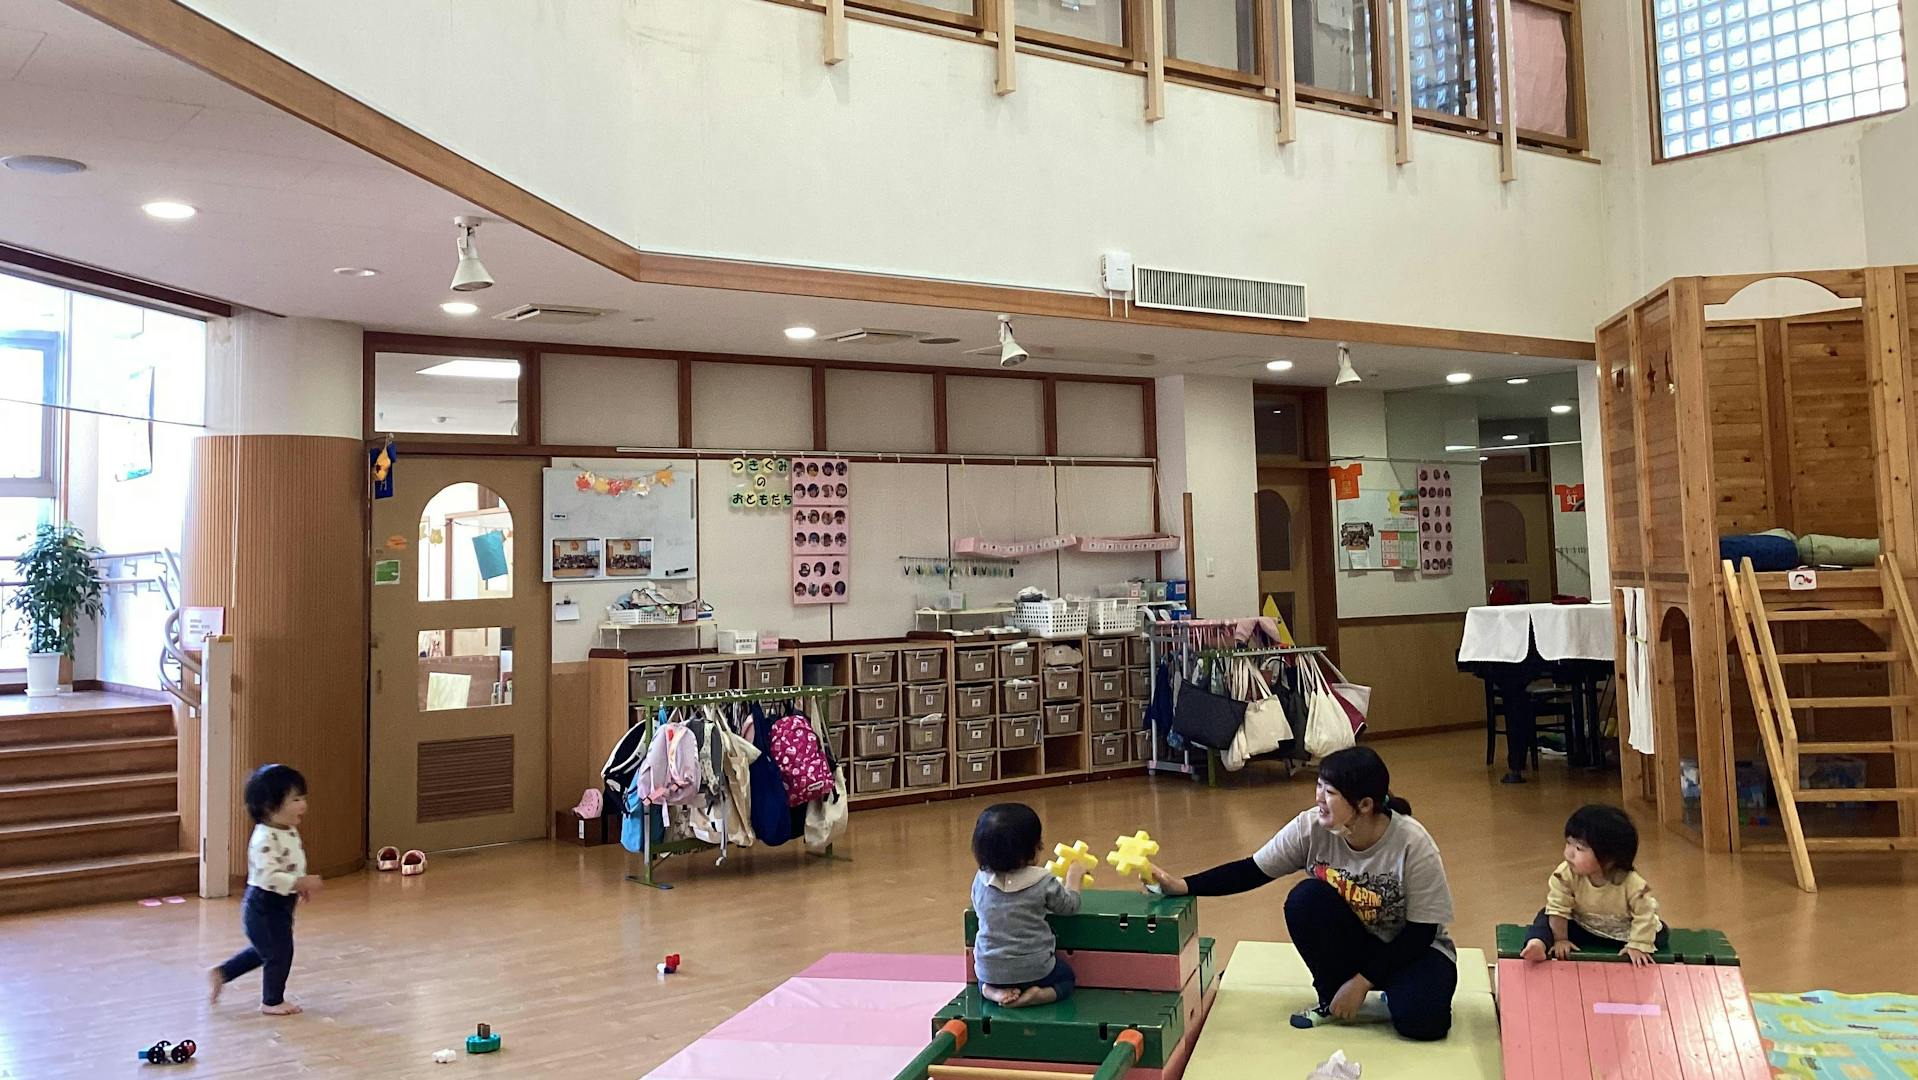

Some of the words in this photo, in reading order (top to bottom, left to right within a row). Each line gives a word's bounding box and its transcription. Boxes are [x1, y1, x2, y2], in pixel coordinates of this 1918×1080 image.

[733, 459, 788, 471] つきぐみ
[756, 476, 767, 487] の
[732, 493, 792, 506] おともだち
